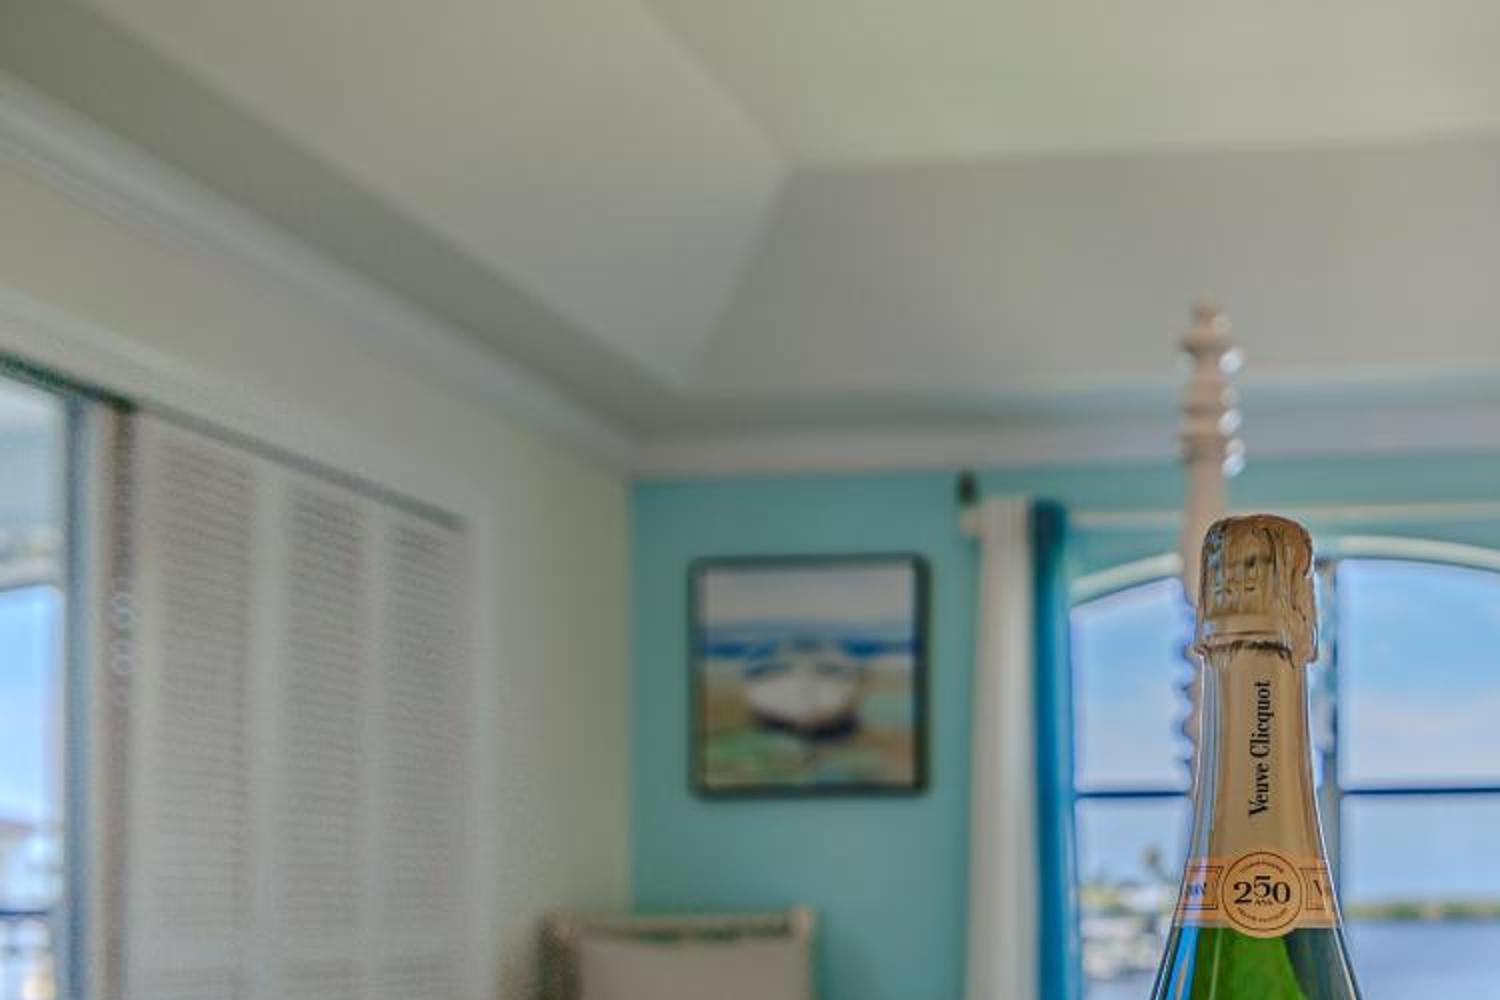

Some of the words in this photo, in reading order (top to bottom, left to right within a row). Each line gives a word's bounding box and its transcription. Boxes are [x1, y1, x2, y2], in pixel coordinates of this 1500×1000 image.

[1250, 680, 1275, 758] Clicquot
[1248, 763, 1270, 817] Veuve
[1233, 875, 1291, 905] 250
